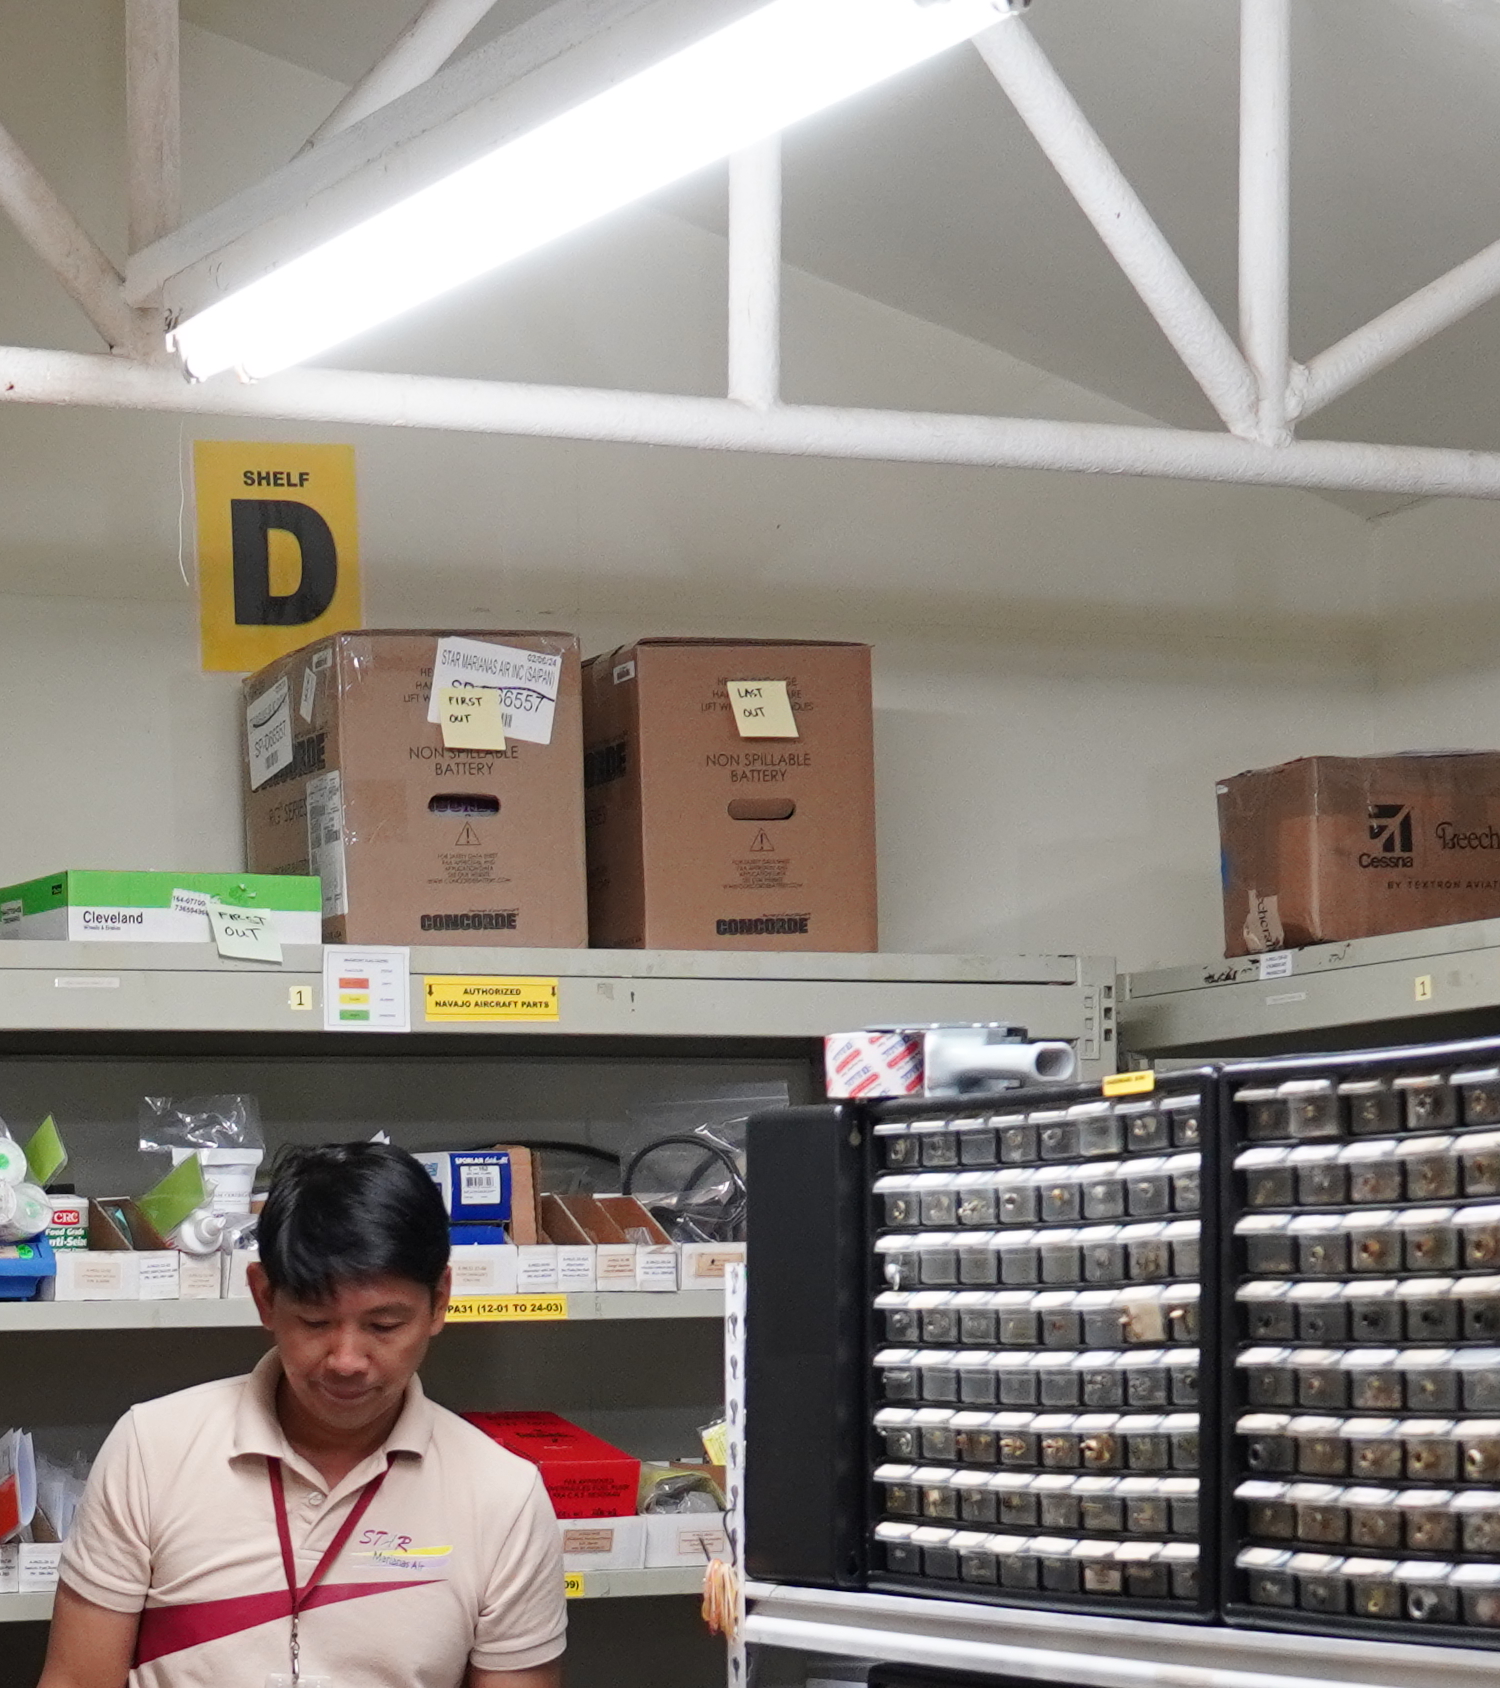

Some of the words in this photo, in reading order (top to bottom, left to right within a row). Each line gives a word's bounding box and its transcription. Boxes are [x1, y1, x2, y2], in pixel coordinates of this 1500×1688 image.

[241, 469, 310, 488] SHELF
[230, 498, 339, 627] D
[441, 649, 461, 668] STAR
[461, 653, 498, 676] MARIANAS
[737, 687, 763, 699] LAST
[448, 696, 483, 708] FIRST
[449, 713, 472, 725] OUT
[742, 707, 766, 719] OUT
[409, 746, 444, 760] NON
[706, 753, 740, 767] NON
[744, 753, 812, 767] SPILLABLE
[435, 762, 494, 776] BATTERY
[731, 769, 788, 783] BATTERY
[1358, 852, 1414, 868] Cessna
[1387, 881, 1401, 889] BY
[1407, 880, 1461, 889] TEXTRON
[82, 910, 144, 925] Cleveland
[217, 910, 267, 926] FIRST
[420, 912, 519, 931] CONCORDE
[223, 925, 262, 941] OUT
[715, 917, 809, 936] CONCORDE
[462, 987, 522, 996] AUTHORIZED
[1419, 980, 1428, 996] 1
[296, 990, 305, 1005] 1
[434, 1000, 472, 1009] NAVAJO
[473, 1000, 519, 1009] AIRCRAFT
[521, 1000, 550, 1009] PARTS
[53, 1211, 80, 1223] CRC
[446, 1303, 473, 1314] PA31
[477, 1303, 509, 1315] (12-01
[512, 1303, 527, 1313] TO
[529, 1302, 564, 1314] 24-03)
[372, 1550, 411, 1569] Marianas
[411, 1562, 426, 1571] Air
